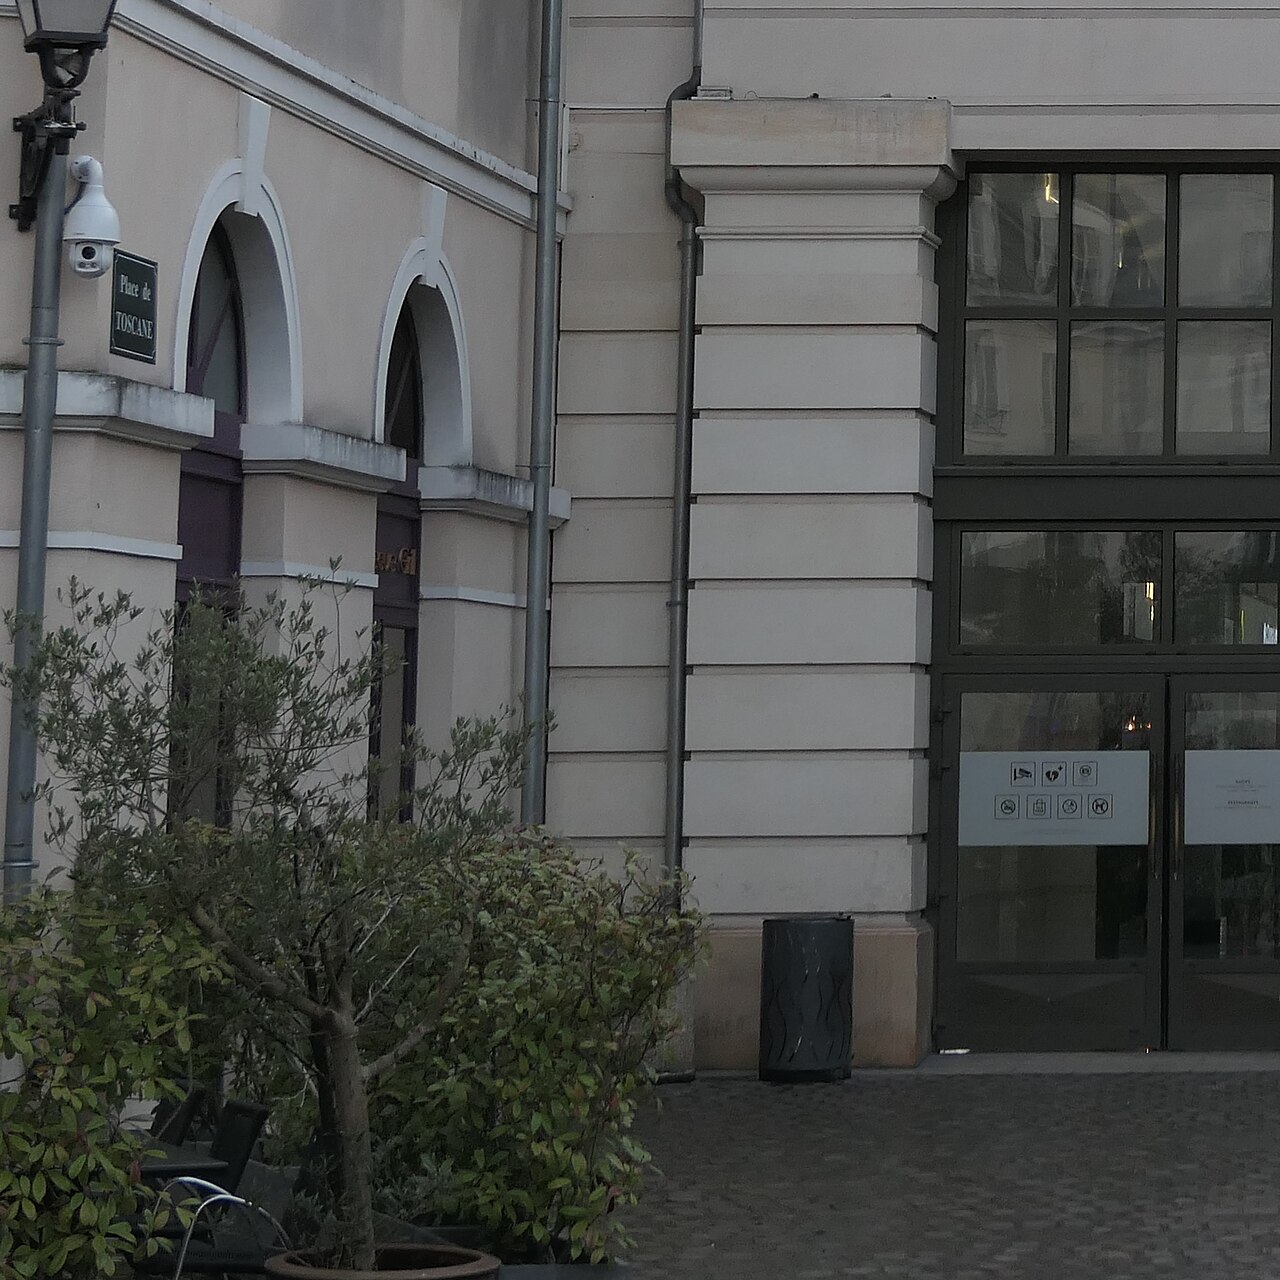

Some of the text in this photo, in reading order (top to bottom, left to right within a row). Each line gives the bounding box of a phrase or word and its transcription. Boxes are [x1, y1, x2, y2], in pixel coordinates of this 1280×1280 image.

[120, 274, 151, 301] Place de
[115, 311, 154, 340] TOSCANE
